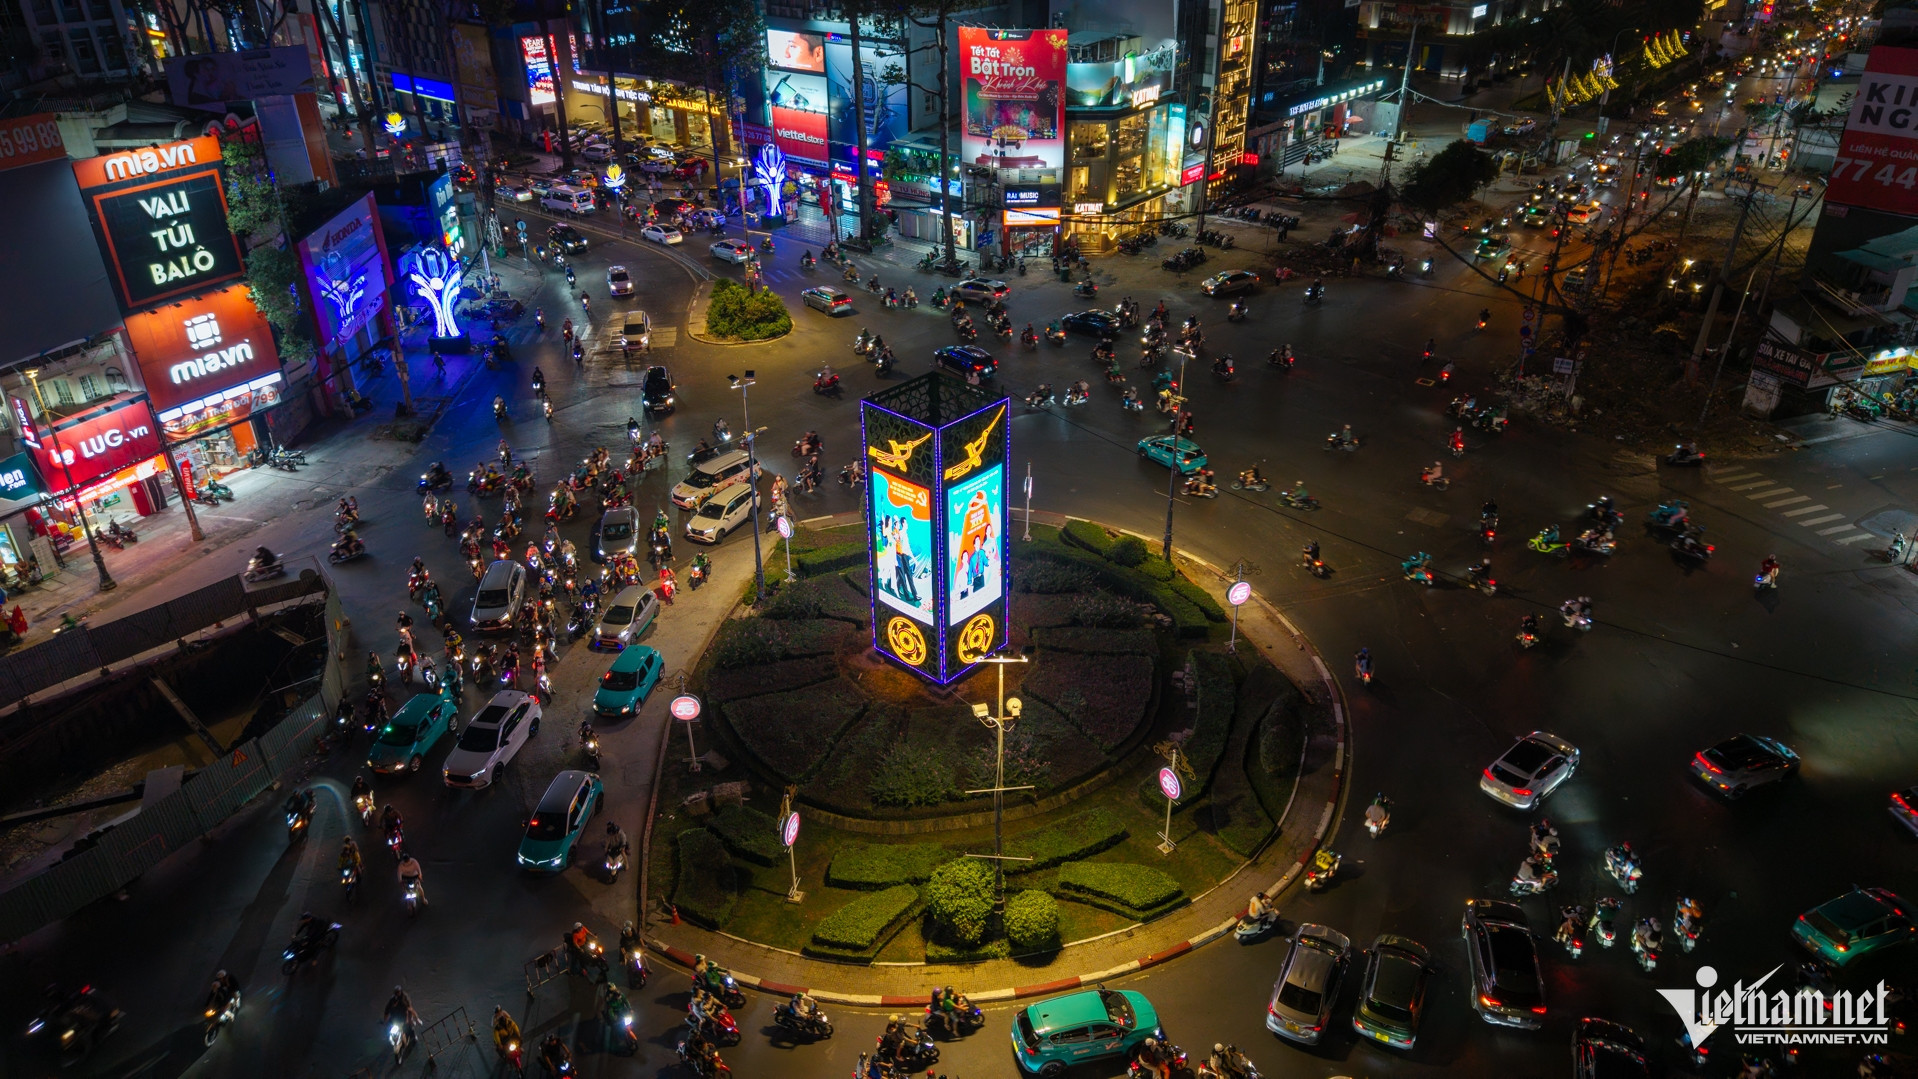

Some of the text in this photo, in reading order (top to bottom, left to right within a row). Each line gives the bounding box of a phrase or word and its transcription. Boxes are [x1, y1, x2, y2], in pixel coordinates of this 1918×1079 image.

[970, 45, 984, 56] Tết
[971, 57, 1035, 80] Bật Trọn
[1859, 104, 1918, 130] NG
[12, 125, 39, 154] 99
[36, 121, 62, 149] 88
[104, 144, 196, 181] mia.vn
[138, 190, 191, 219] VALI
[150, 221, 196, 252] TÚI
[331, 217, 363, 247] HONDA
[149, 245, 215, 285] BALÔ
[170, 341, 253, 384] mia.vn
[79, 425, 149, 459] LUG.vn
